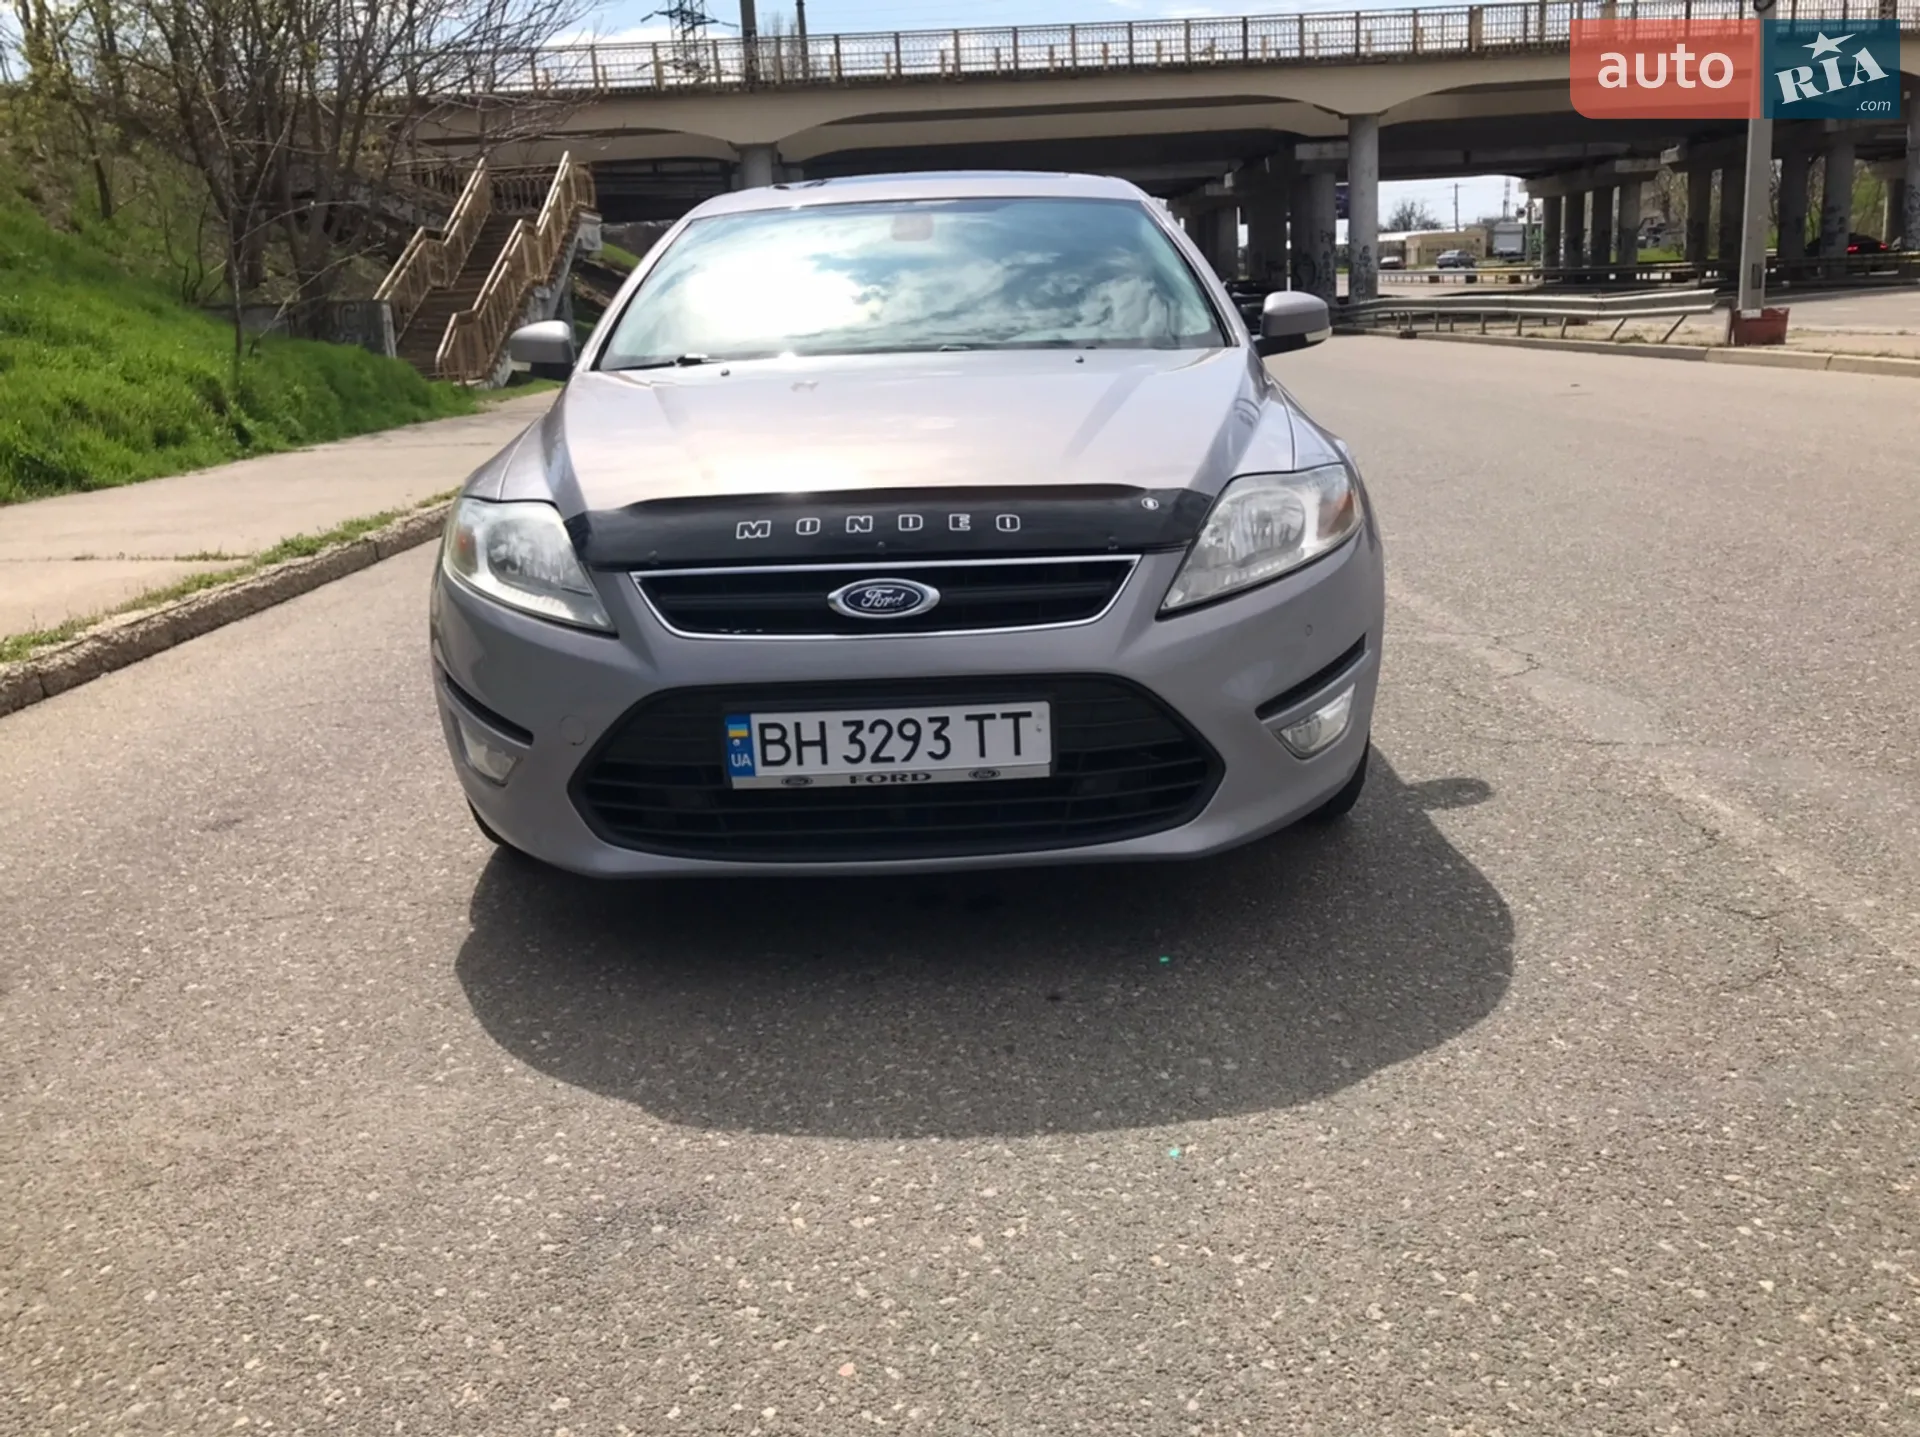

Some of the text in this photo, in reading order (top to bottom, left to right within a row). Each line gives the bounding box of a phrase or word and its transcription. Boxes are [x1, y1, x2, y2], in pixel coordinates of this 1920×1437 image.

[736, 514, 1020, 539] MONDEO
[861, 589, 905, 607] Ford
[758, 711, 1032, 767] BH 3293 TT
[731, 753, 752, 767] UA
[850, 772, 932, 784] FORD
